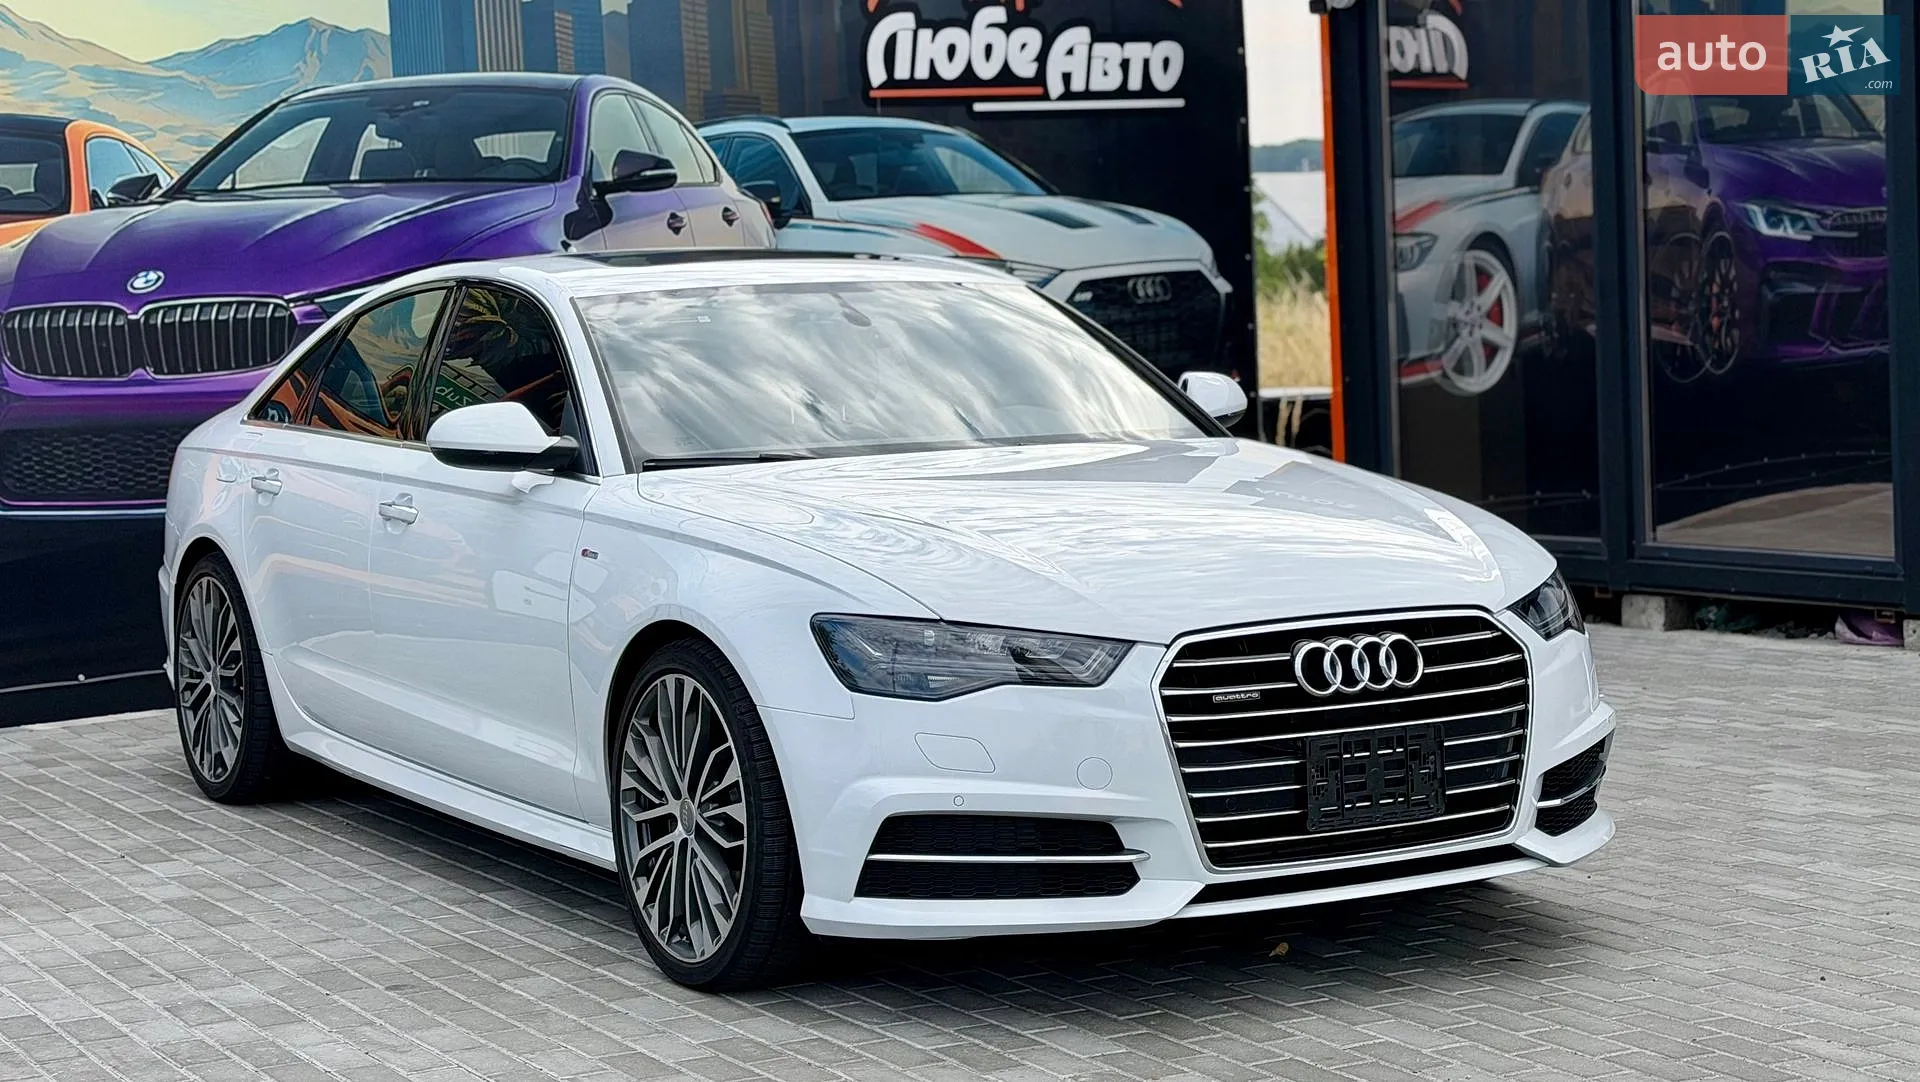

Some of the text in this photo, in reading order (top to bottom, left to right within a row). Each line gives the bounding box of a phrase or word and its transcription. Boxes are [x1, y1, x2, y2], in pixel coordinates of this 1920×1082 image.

[866, 5, 1184, 101] Любе Авто
[1214, 692, 1260, 702] quattro
